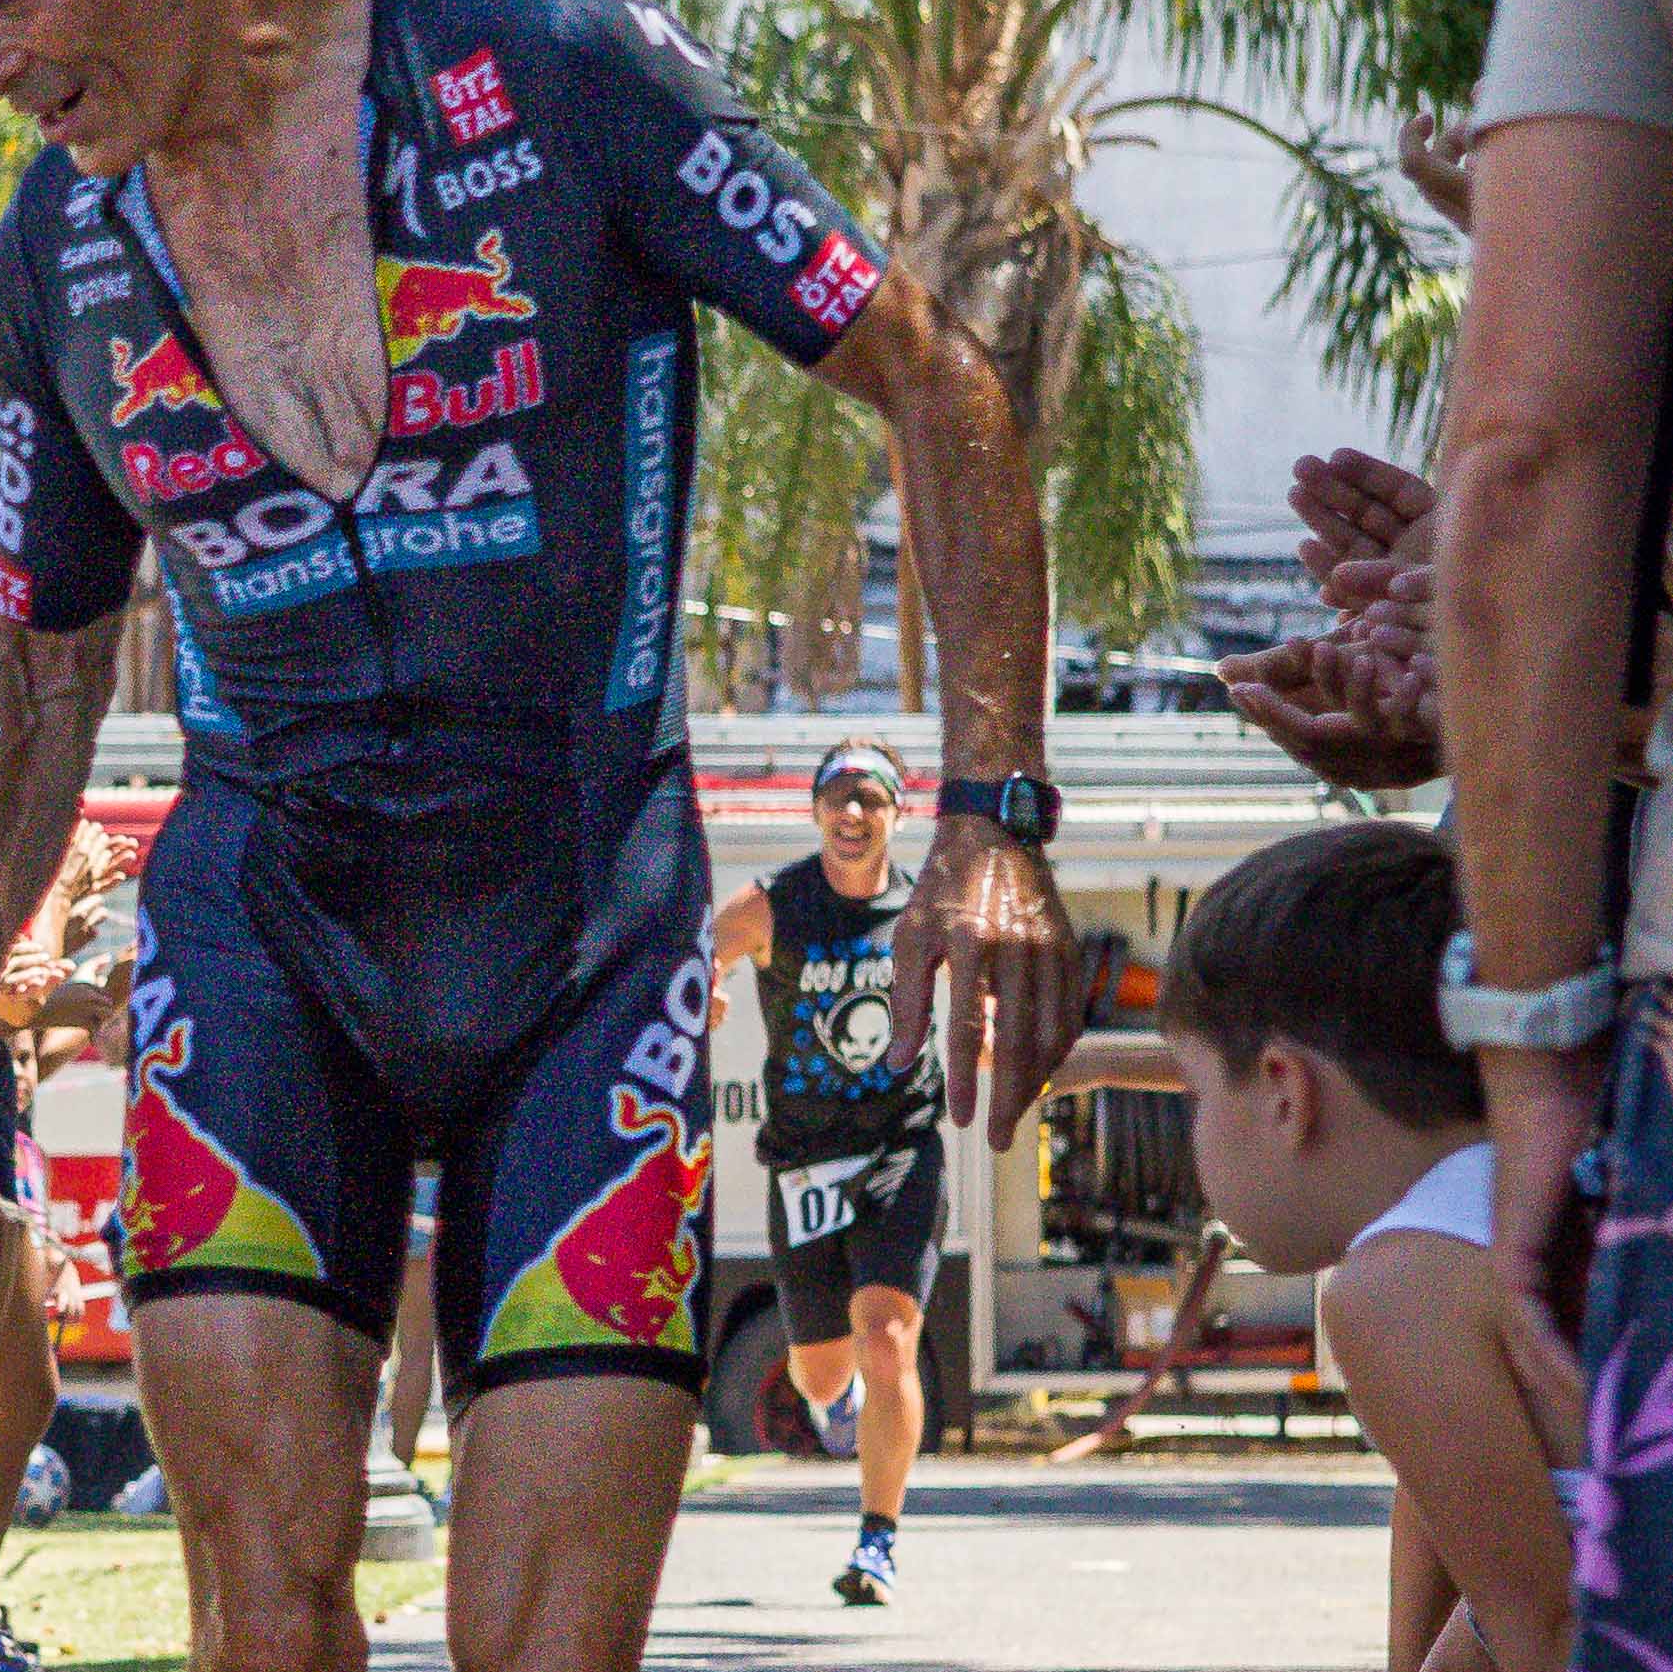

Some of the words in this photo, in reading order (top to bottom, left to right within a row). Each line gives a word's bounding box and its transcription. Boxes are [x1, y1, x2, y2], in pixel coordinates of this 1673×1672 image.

[450, 96, 515, 141] TAL
[434, 138, 543, 211] BOSS
[123, 412, 270, 503] Red
[388, 337, 544, 437] Bull
[170, 442, 533, 569] BORA
